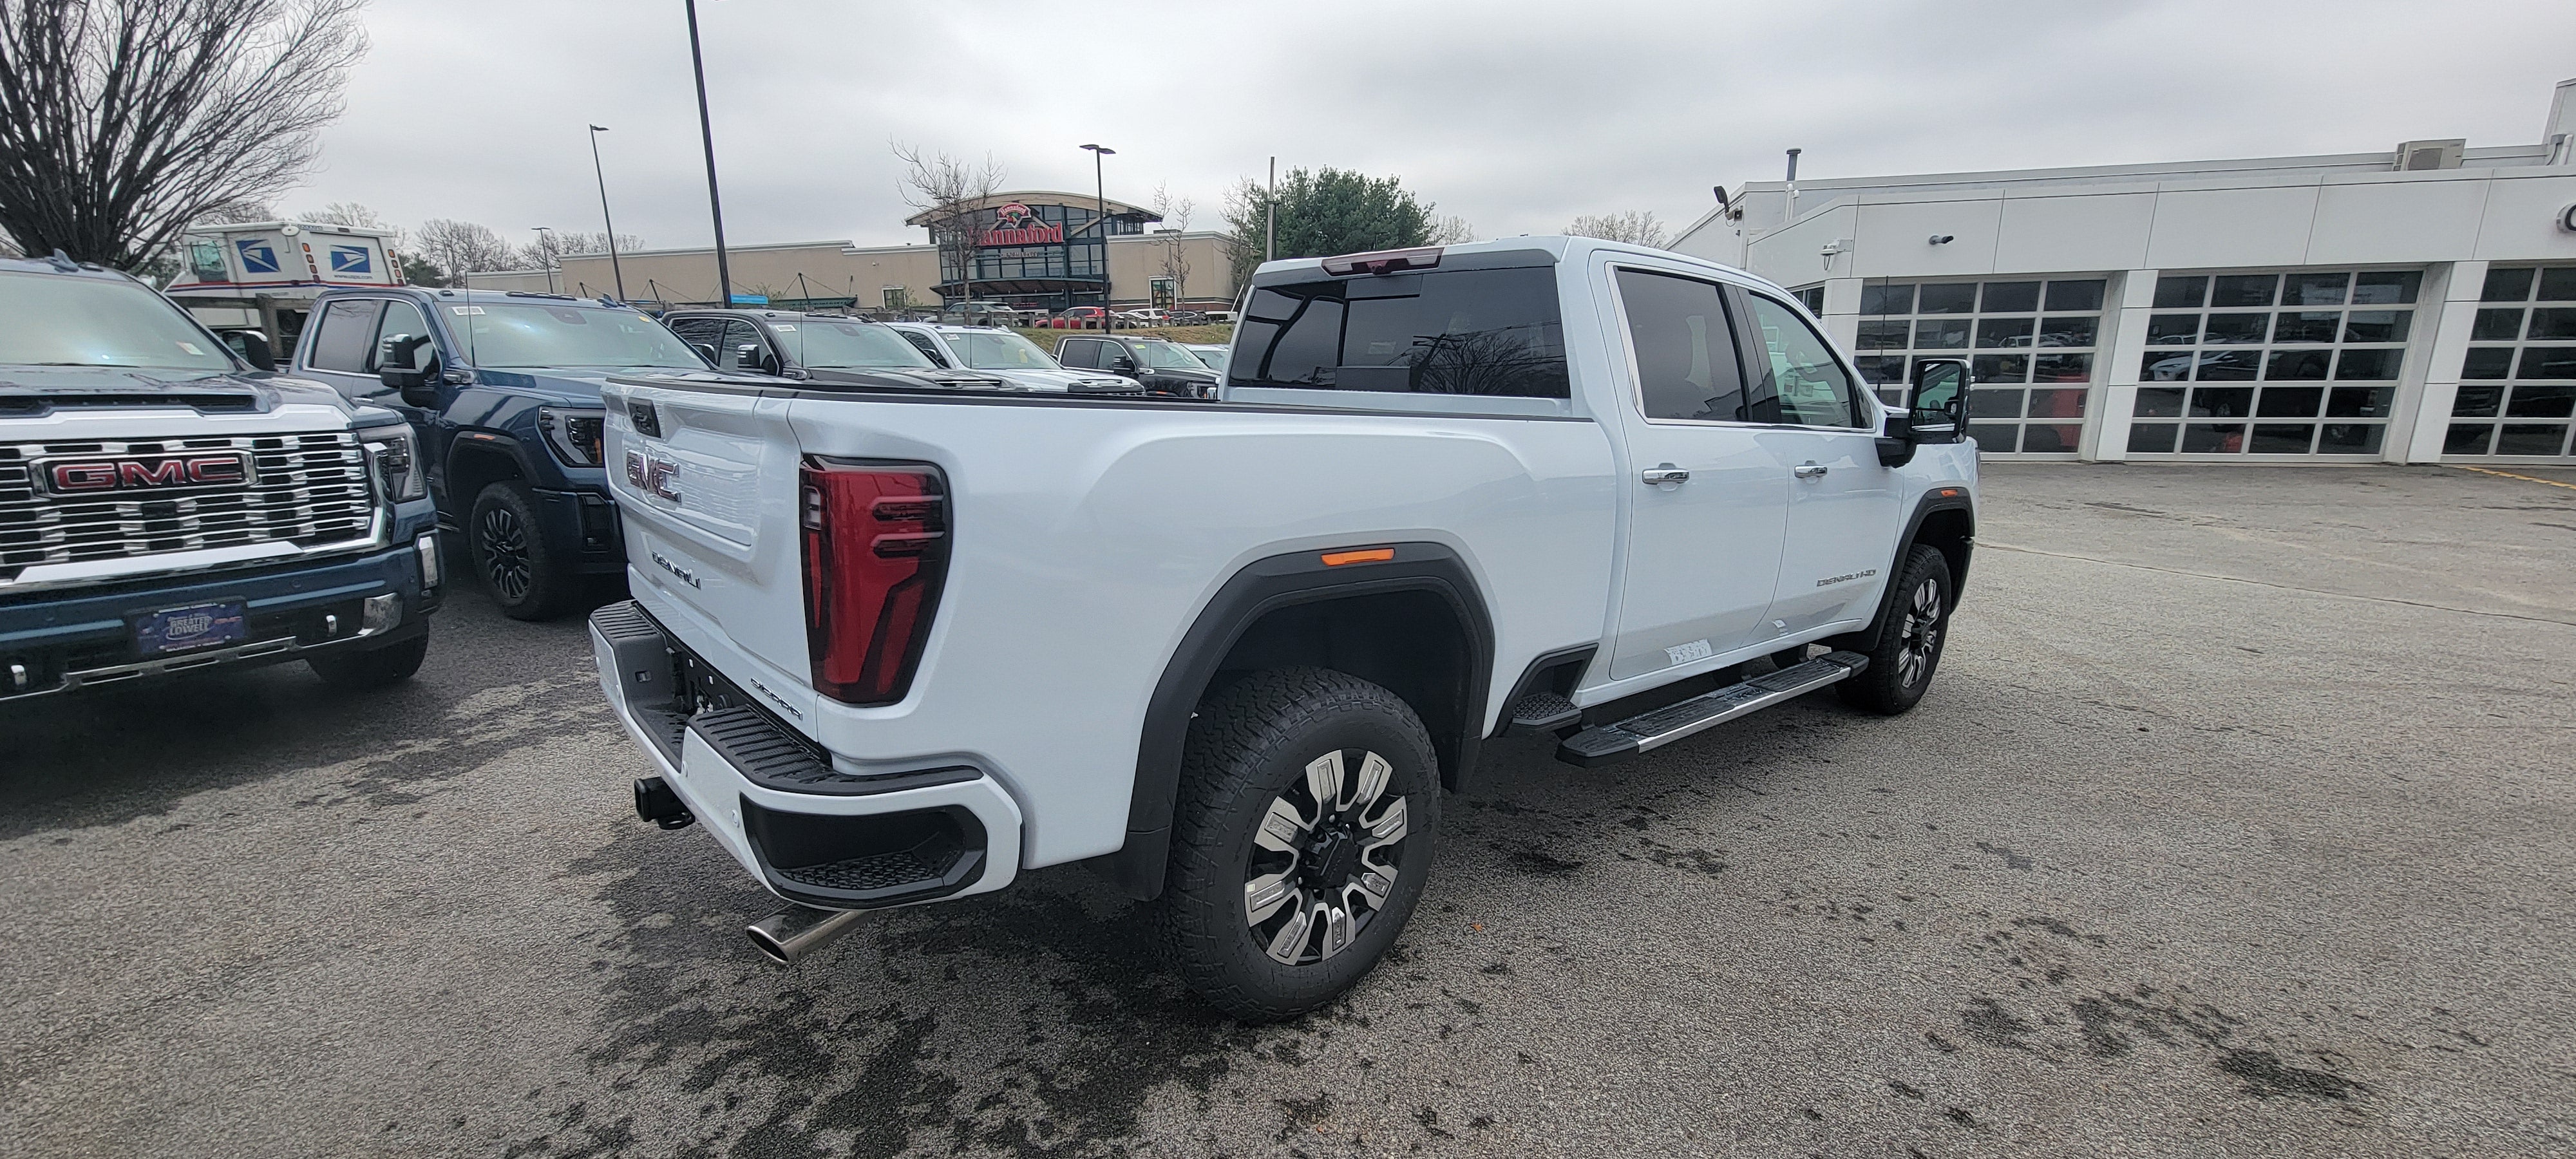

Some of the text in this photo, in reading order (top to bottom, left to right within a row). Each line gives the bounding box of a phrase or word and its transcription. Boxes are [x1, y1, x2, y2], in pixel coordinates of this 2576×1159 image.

[1001, 205, 1027, 214] Hannaford
[52, 457, 242, 490] GMC
[627, 450, 682, 505] GMC
[652, 551, 701, 591] DENALI
[1817, 569, 1877, 587] DENALI HD
[169, 623, 209, 636] LOWELL
[170, 616, 212, 628] GREATER
[750, 677, 803, 721] SIERRA
